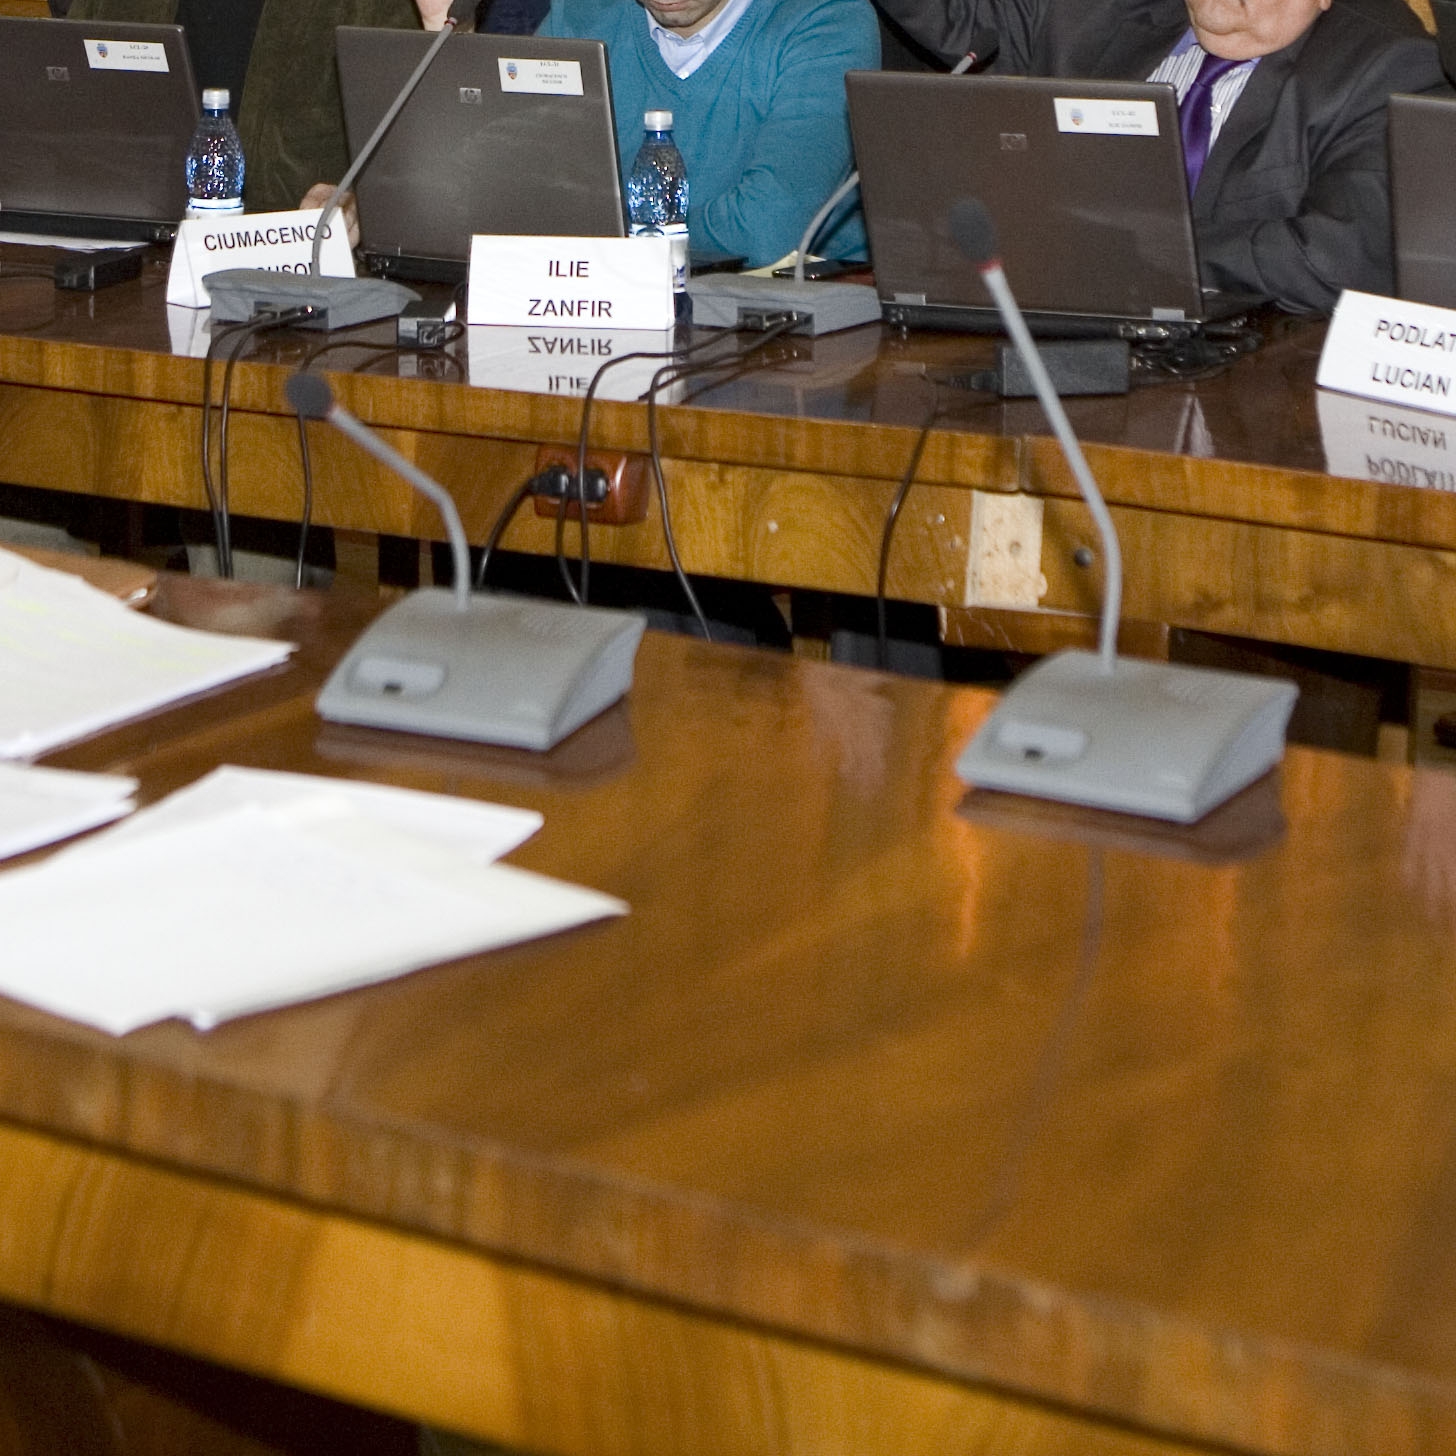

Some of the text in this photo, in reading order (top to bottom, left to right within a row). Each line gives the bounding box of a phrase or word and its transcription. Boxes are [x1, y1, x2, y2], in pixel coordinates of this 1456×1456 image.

[204, 224, 332, 251] CIUMACENCO
[548, 260, 590, 278] ILIE
[527, 299, 613, 318] ZANFIR
[1370, 362, 1452, 397] LUCIAN
